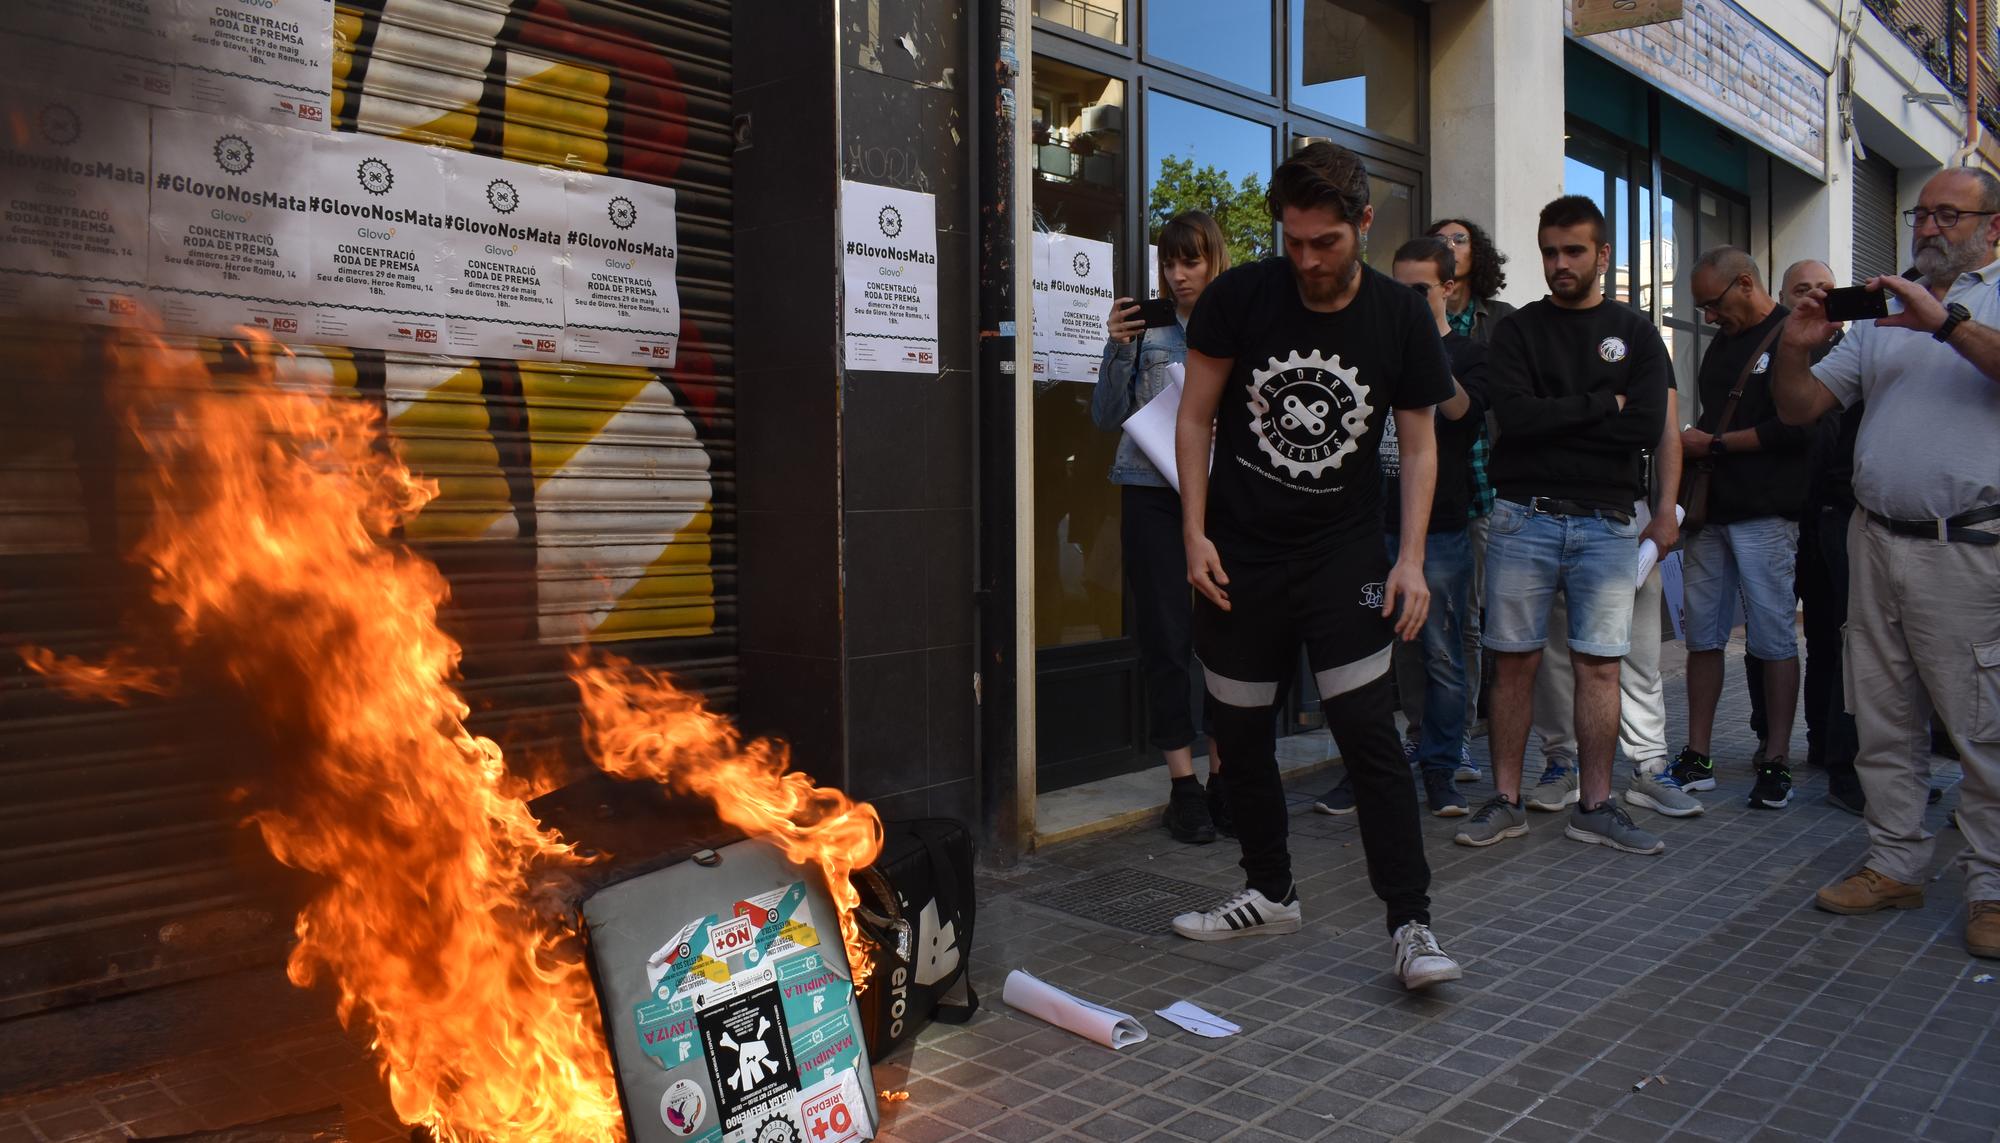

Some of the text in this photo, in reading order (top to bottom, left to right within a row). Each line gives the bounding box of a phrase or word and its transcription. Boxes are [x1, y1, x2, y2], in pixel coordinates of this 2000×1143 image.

[157, 173, 306, 212] #GlovoNosMata
[211, 209, 247, 223] Glovo
[309, 196, 442, 229] #GlovoNosMata
[189, 225, 274, 245] CONCENTRACIÓ
[357, 228, 391, 240] Glovo
[445, 214, 561, 245] #GlovoNosMata
[183, 236, 279, 256] RODA DE PREMSA
[485, 244, 513, 257] Glovo
[567, 231, 674, 258] #GlovoNosMata
[846, 241, 935, 264] #GlovoNosMata
[188, 250, 228, 260] dimecres
[254, 259, 275, 267] maig
[338, 245, 416, 261] CONCENTRACIÓ
[165, 255, 182, 264] Seu
[196, 259, 222, 268] Glovo.
[287, 270, 296, 278] 14
[334, 254, 419, 272] RODA DE PREMSA
[468, 260, 536, 276] CONCENTRACIÓ
[605, 258, 631, 270] Glovo
[338, 267, 374, 276] dimecres
[376, 270, 385, 278] 29
[397, 274, 415, 282] maig
[464, 269, 540, 285] RODA DE PREMSA
[879, 266, 900, 277] Glovo
[317, 273, 332, 281] Seu
[345, 276, 369, 284] Glovo.
[371, 279, 394, 287] Heroe
[396, 282, 423, 291] Romeu,
[425, 284, 433, 292] 14
[469, 281, 500, 290] dimecres
[521, 288, 537, 296] maig
[588, 282, 657, 295] RODA DE PREMSA
[592, 273, 652, 288] CONCENTRACIÓ
[866, 281, 918, 294] CONCENTRACIÓ
[370, 287, 385, 295] 18h.
[475, 290, 496, 298] Glovo.
[498, 292, 518, 300] Heroe
[519, 296, 544, 304] Romeu,
[591, 293, 621, 301] dimecres
[864, 290, 920, 302] RODA DE PREMSA
[1050, 280, 1112, 298] #GlovoNosMata
[496, 300, 511, 308] 18h.
[416, 329, 437, 339] NO+
[537, 339, 556, 349] NO+
[1264, 369, 1352, 402] RIDERS
[1262, 422, 1342, 461] DERECHOS
[713, 922, 747, 938] PRECARIETAT
[714, 927, 750, 952] NO+
[725, 1101, 768, 1129] DELIVEROO
